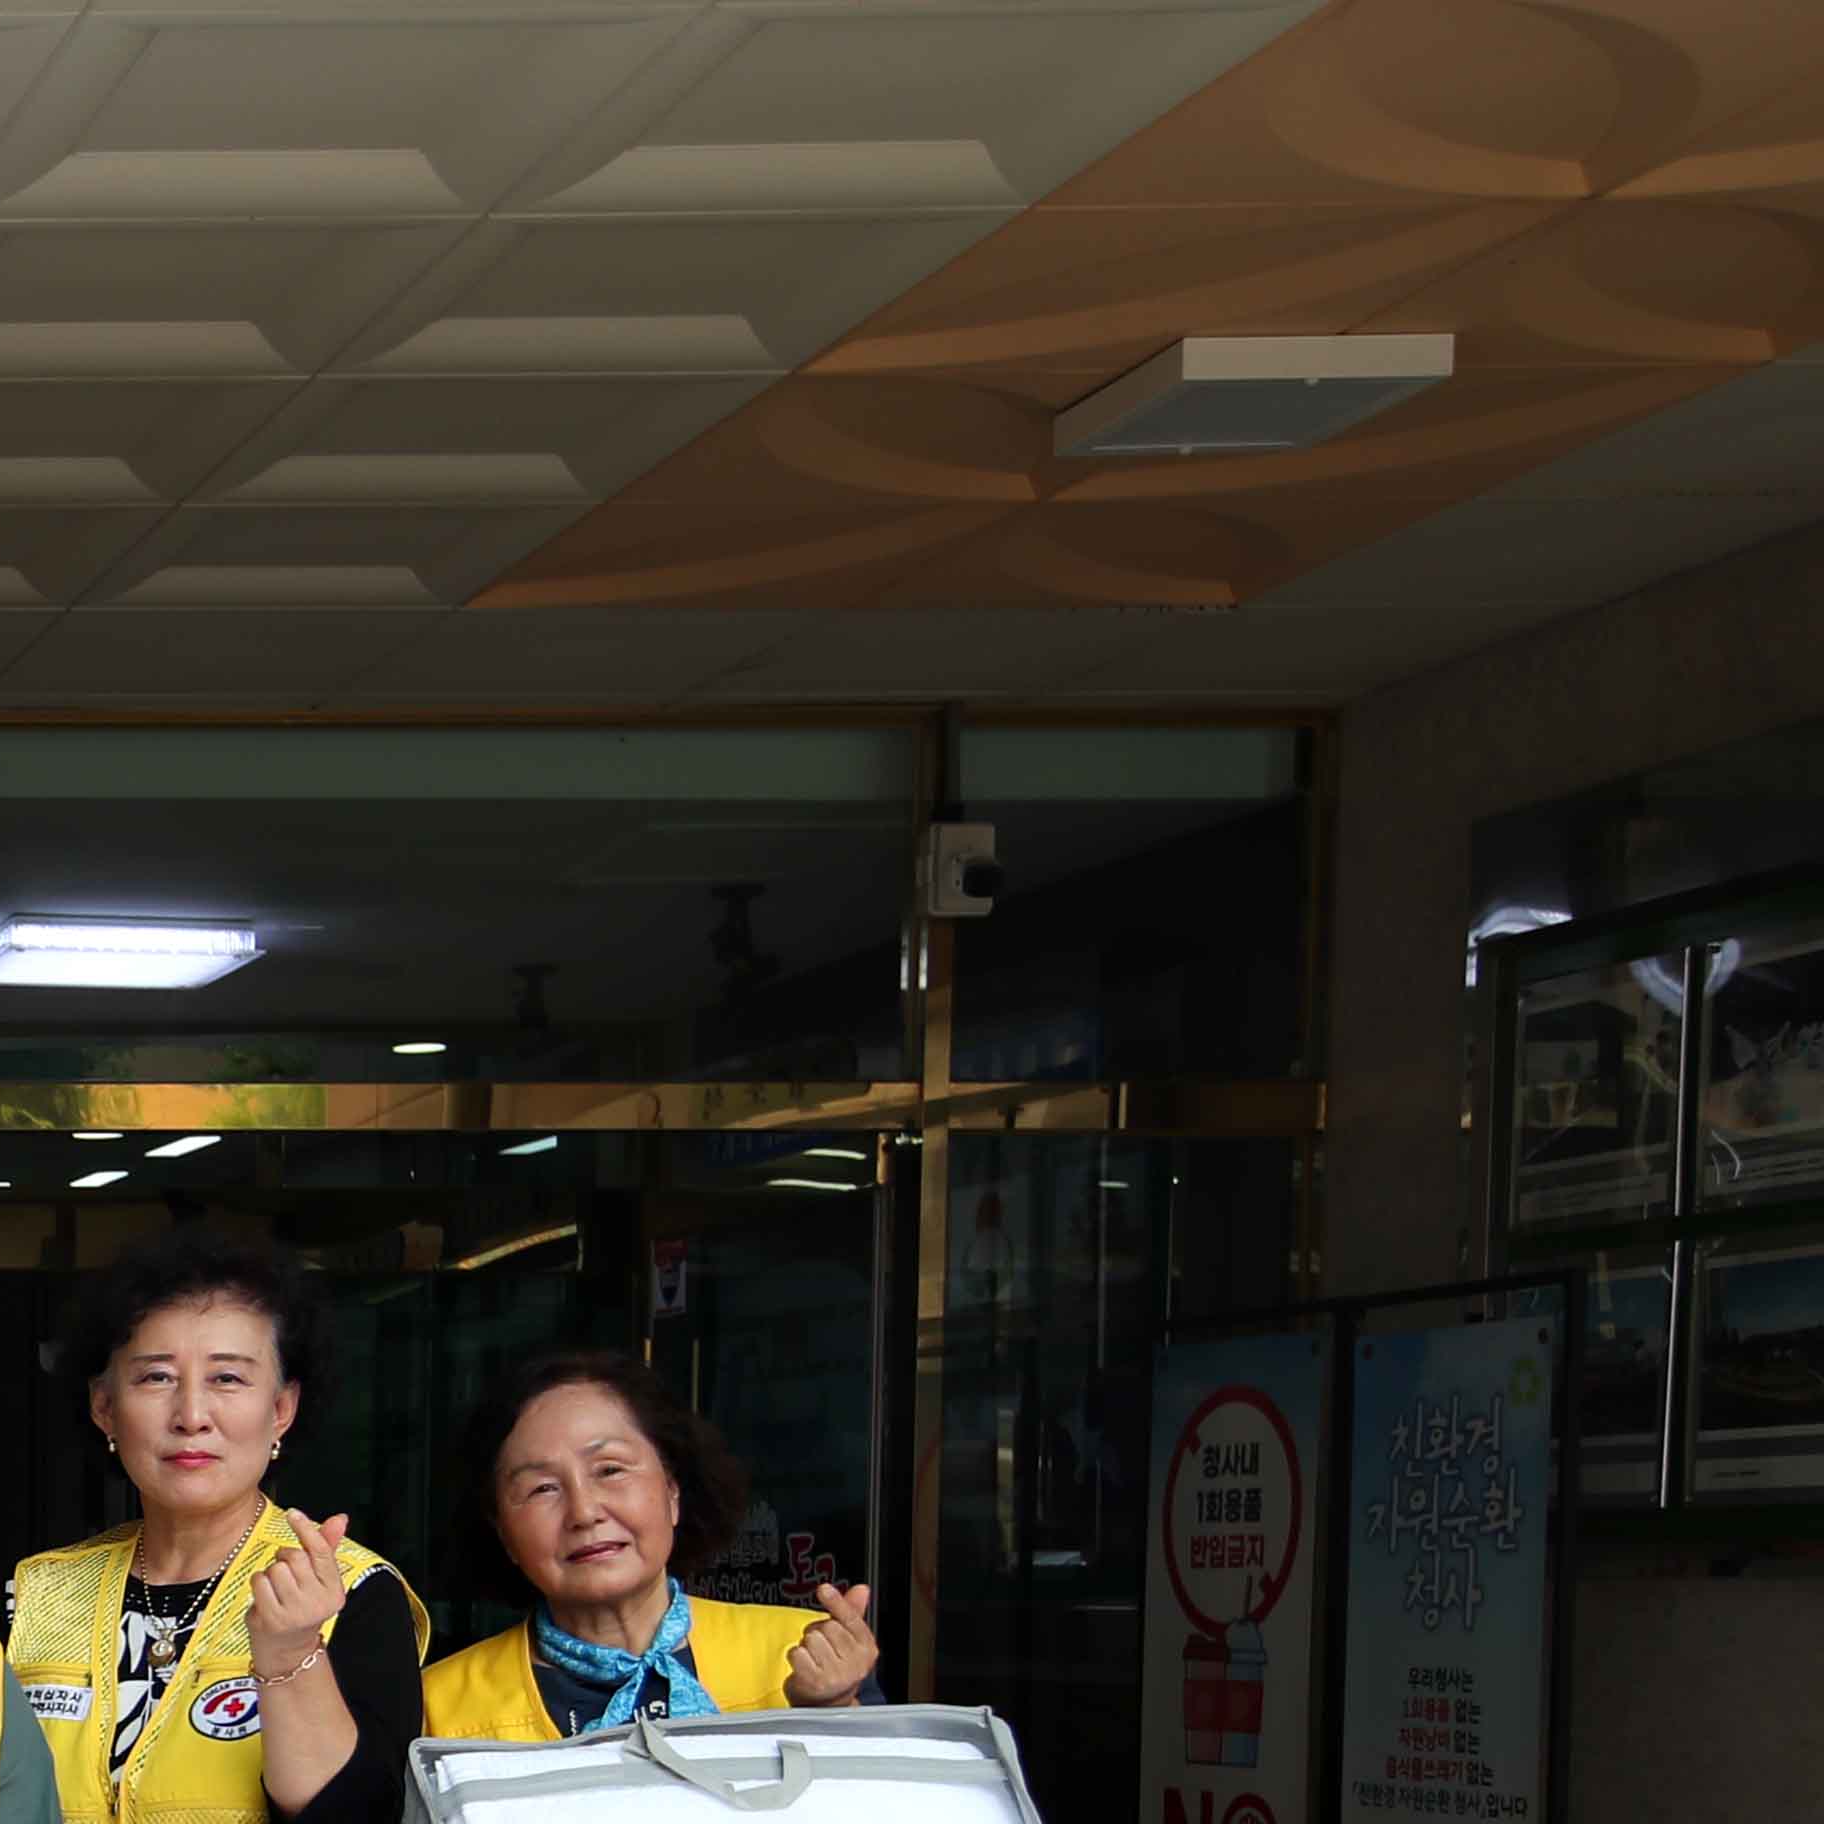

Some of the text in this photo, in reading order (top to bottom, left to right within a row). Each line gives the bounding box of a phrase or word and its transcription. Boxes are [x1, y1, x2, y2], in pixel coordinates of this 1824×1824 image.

[1203, 1442, 1259, 1479] 청사내
[1390, 1394, 1504, 1480] 친환경
[1196, 1488, 1263, 1525] 1회용품
[1368, 1469, 1522, 1553] 자원순환
[1189, 1535, 1265, 1570] 반입금지
[1405, 1551, 1482, 1631] 청사
